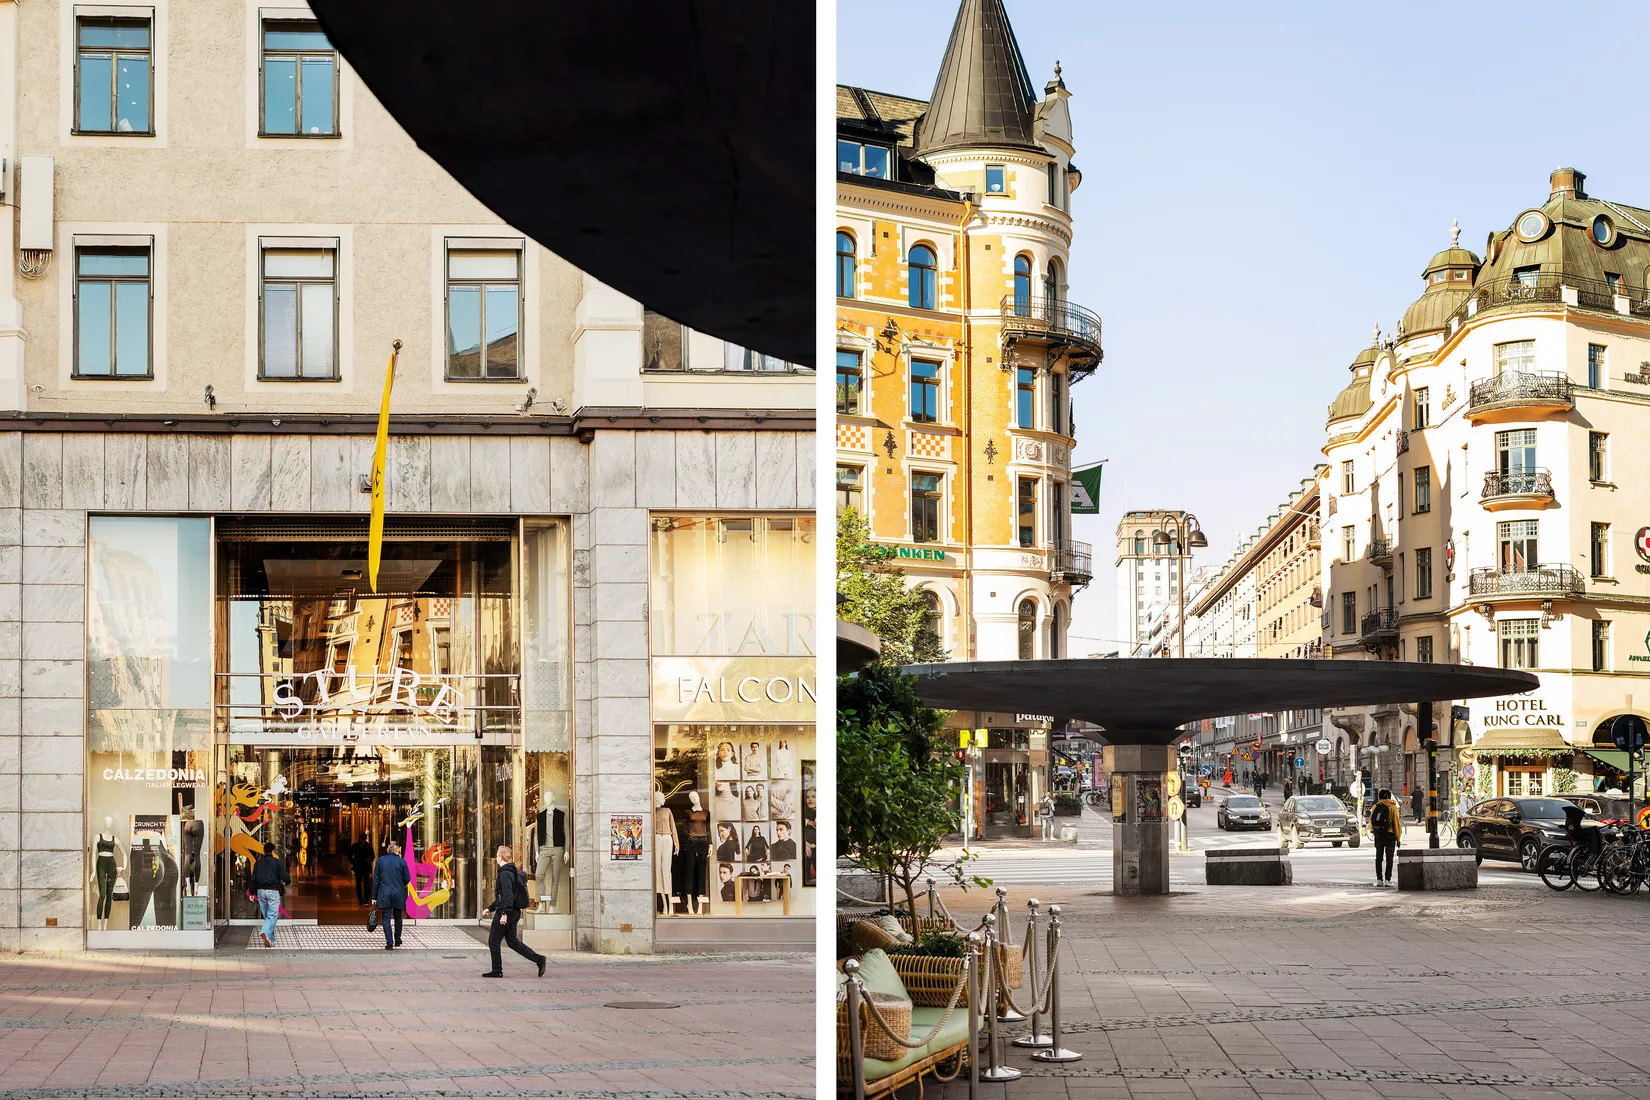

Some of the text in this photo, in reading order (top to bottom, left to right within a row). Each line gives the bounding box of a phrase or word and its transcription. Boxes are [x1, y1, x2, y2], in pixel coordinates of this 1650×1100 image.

[273, 665, 464, 724] STURE
[678, 676, 816, 704] FALCON
[1496, 699, 1547, 711] HOTEL
[1484, 714, 1520, 726] KUNG
[1525, 714, 1565, 726] CARL
[298, 725, 432, 740] GALLERIAN
[103, 768, 206, 781] CALZEDONIA
[172, 781, 206, 789] LEGWEAR
